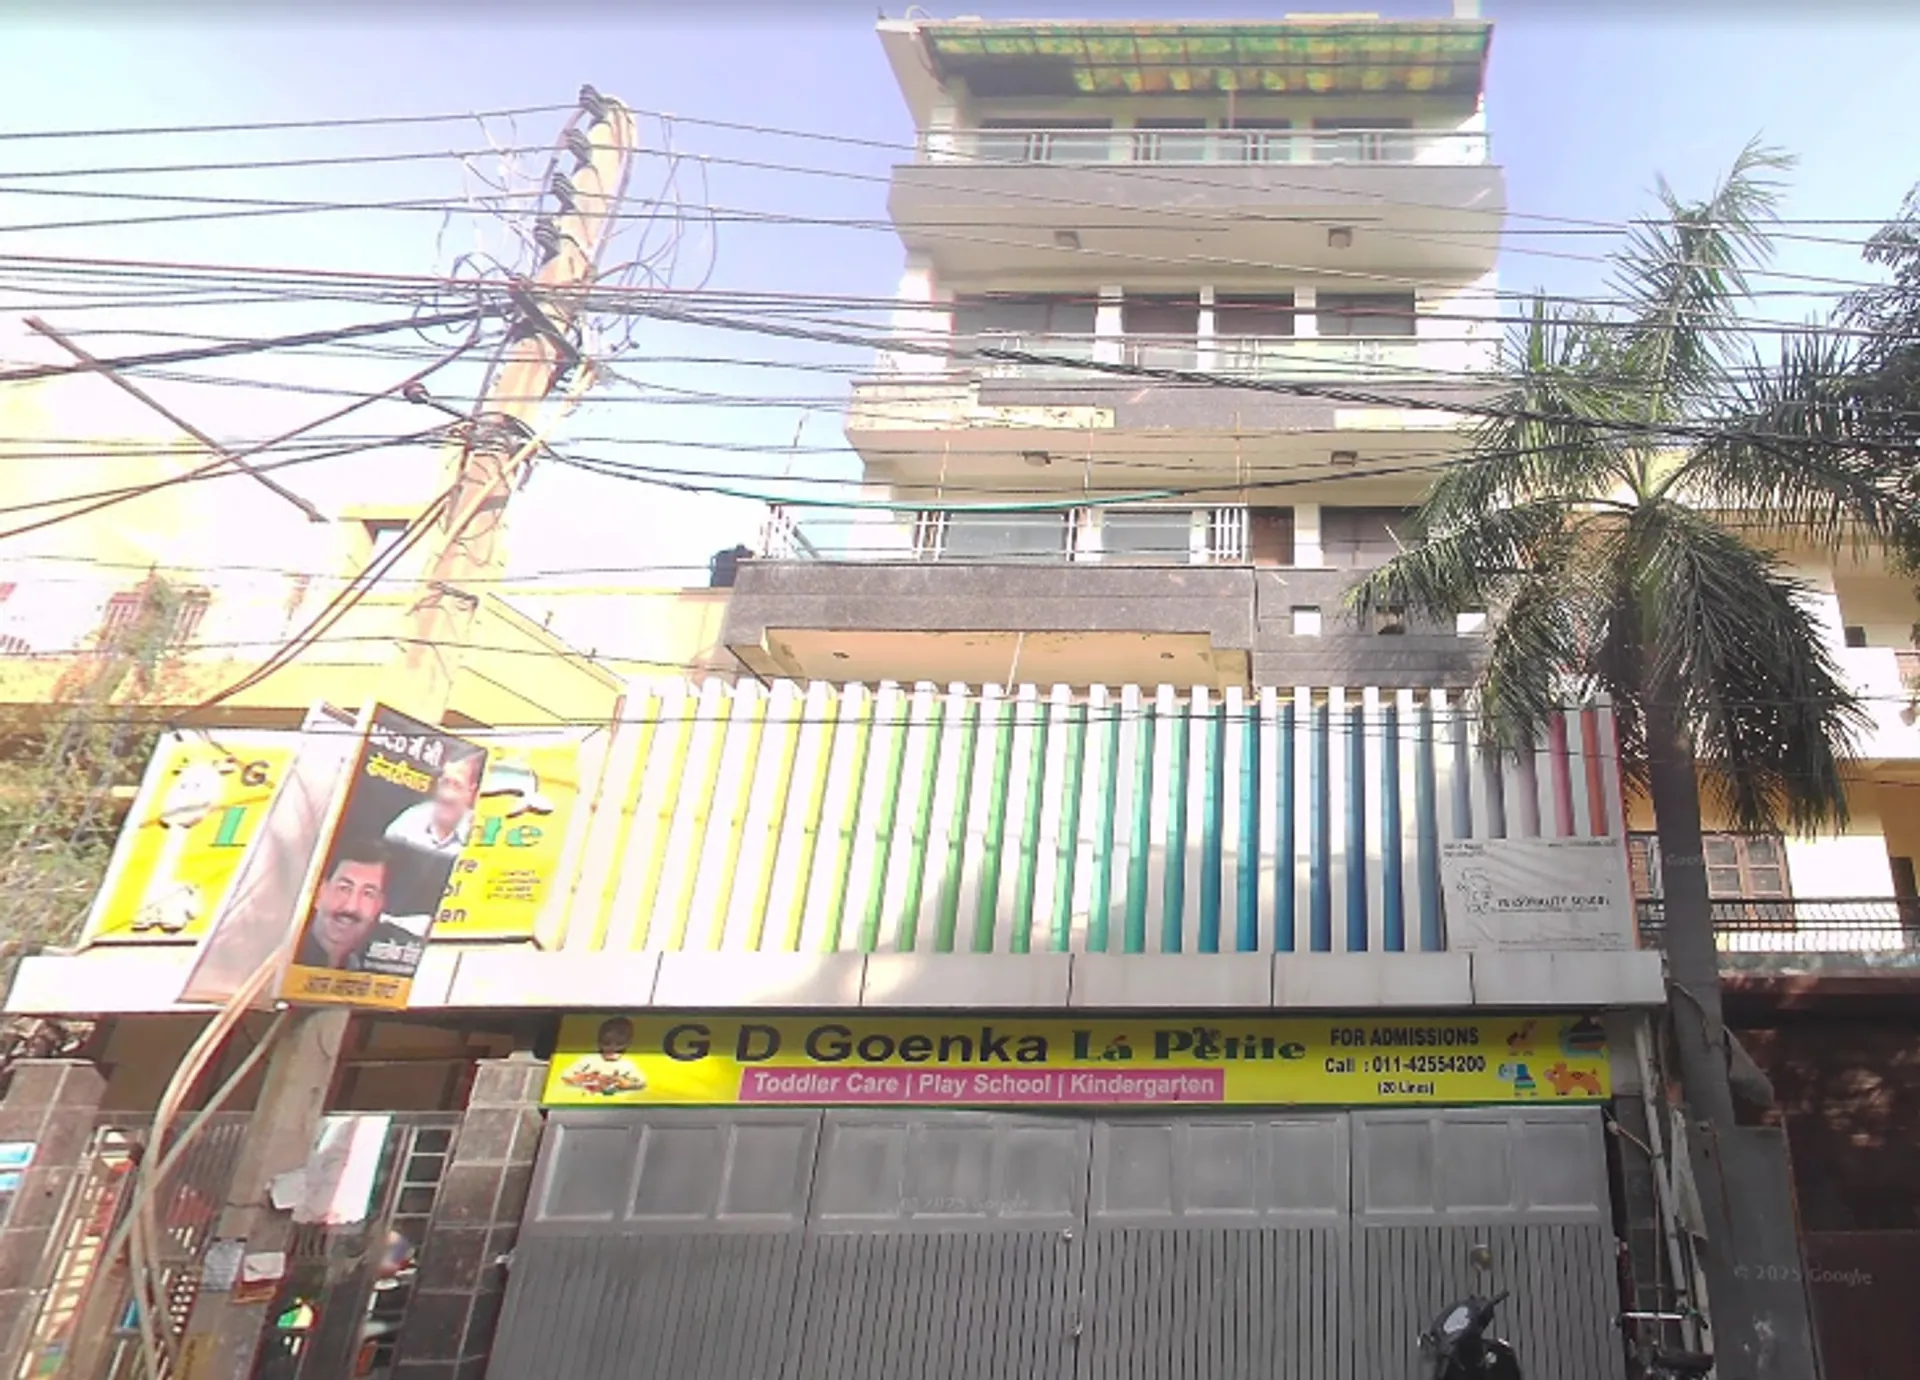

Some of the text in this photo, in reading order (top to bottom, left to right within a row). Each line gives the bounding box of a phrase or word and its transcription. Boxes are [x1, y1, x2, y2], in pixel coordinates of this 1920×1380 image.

[663, 1024, 711, 1062] G
[736, 1024, 782, 1062] D
[804, 1024, 1048, 1062] Goenka
[1330, 1026, 1480, 1046] FOR ADMISSIONS
[1325, 1057, 1355, 1073] Call
[1372, 1055, 1486, 1073] 011-42554200
[754, 1073, 843, 1094] Toddler
[847, 1074, 898, 1094] Care
[919, 1074, 966, 1098] Play
[974, 1073, 1052, 1095] School
[1070, 1074, 1215, 1099] Kindergarten
